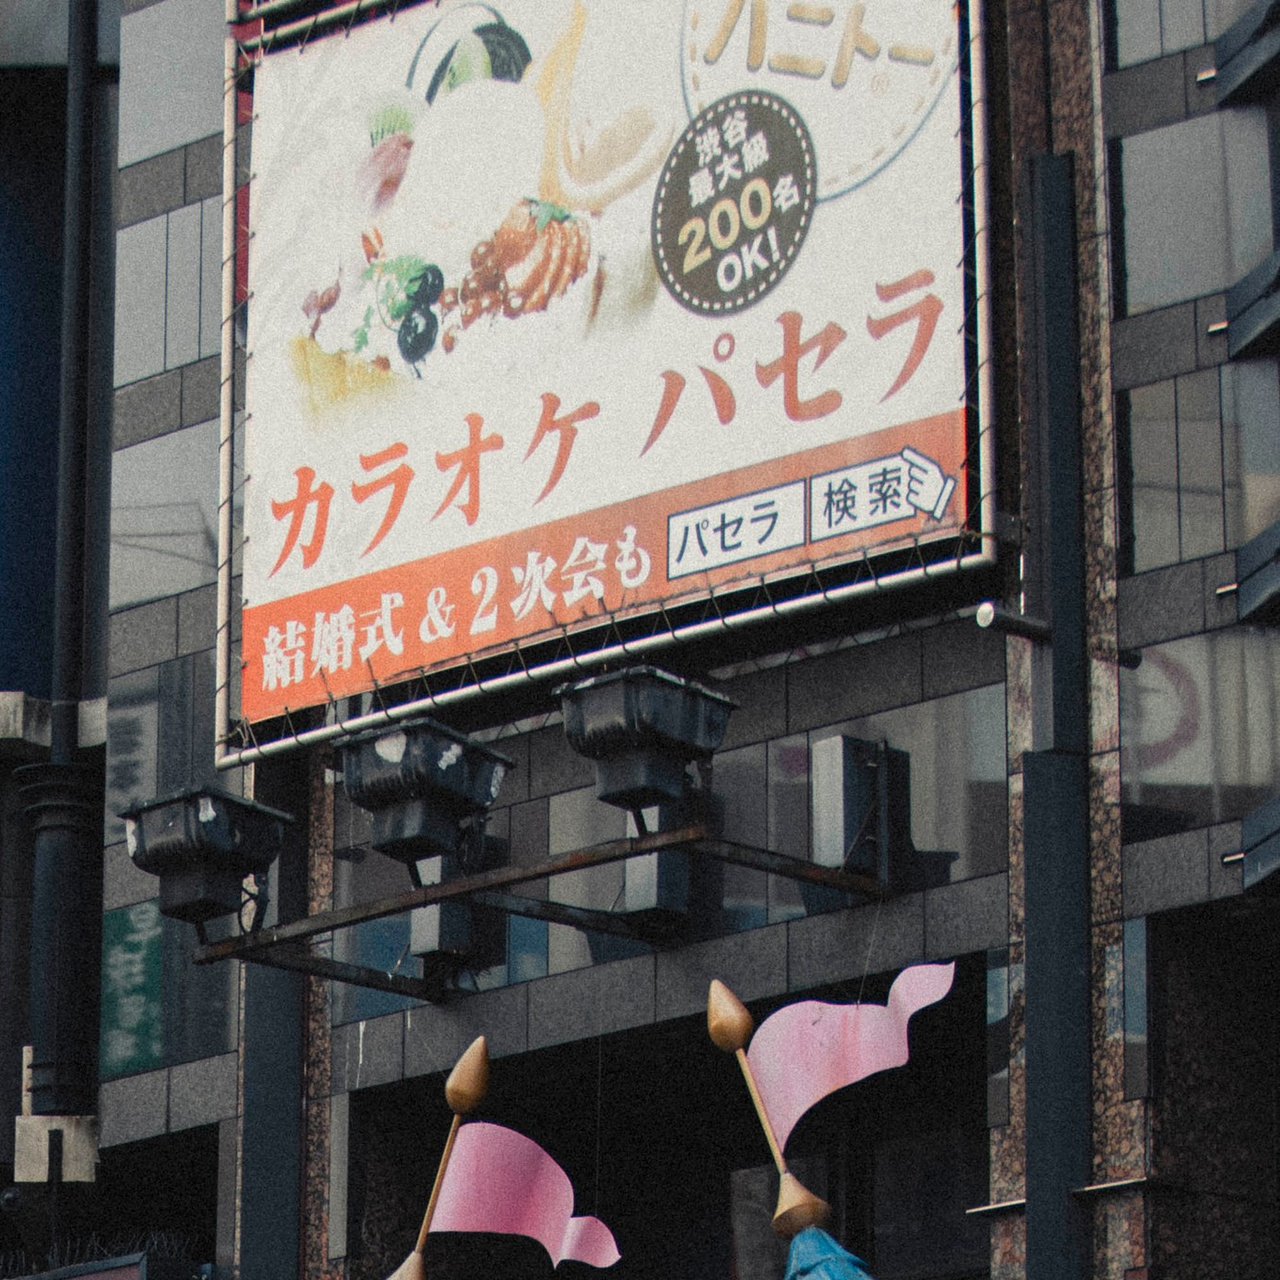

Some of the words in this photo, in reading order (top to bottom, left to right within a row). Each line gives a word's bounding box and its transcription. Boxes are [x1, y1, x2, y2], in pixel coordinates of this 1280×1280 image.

[688, 130, 770, 209] 最大級
[695, 109, 749, 168] 渋谷
[716, 226, 781, 293] OK!
[267, 392, 601, 581] カラオケ
[639, 267, 946, 458] パセラ
[822, 467, 907, 521] 検索
[674, 497, 782, 565] パセラ
